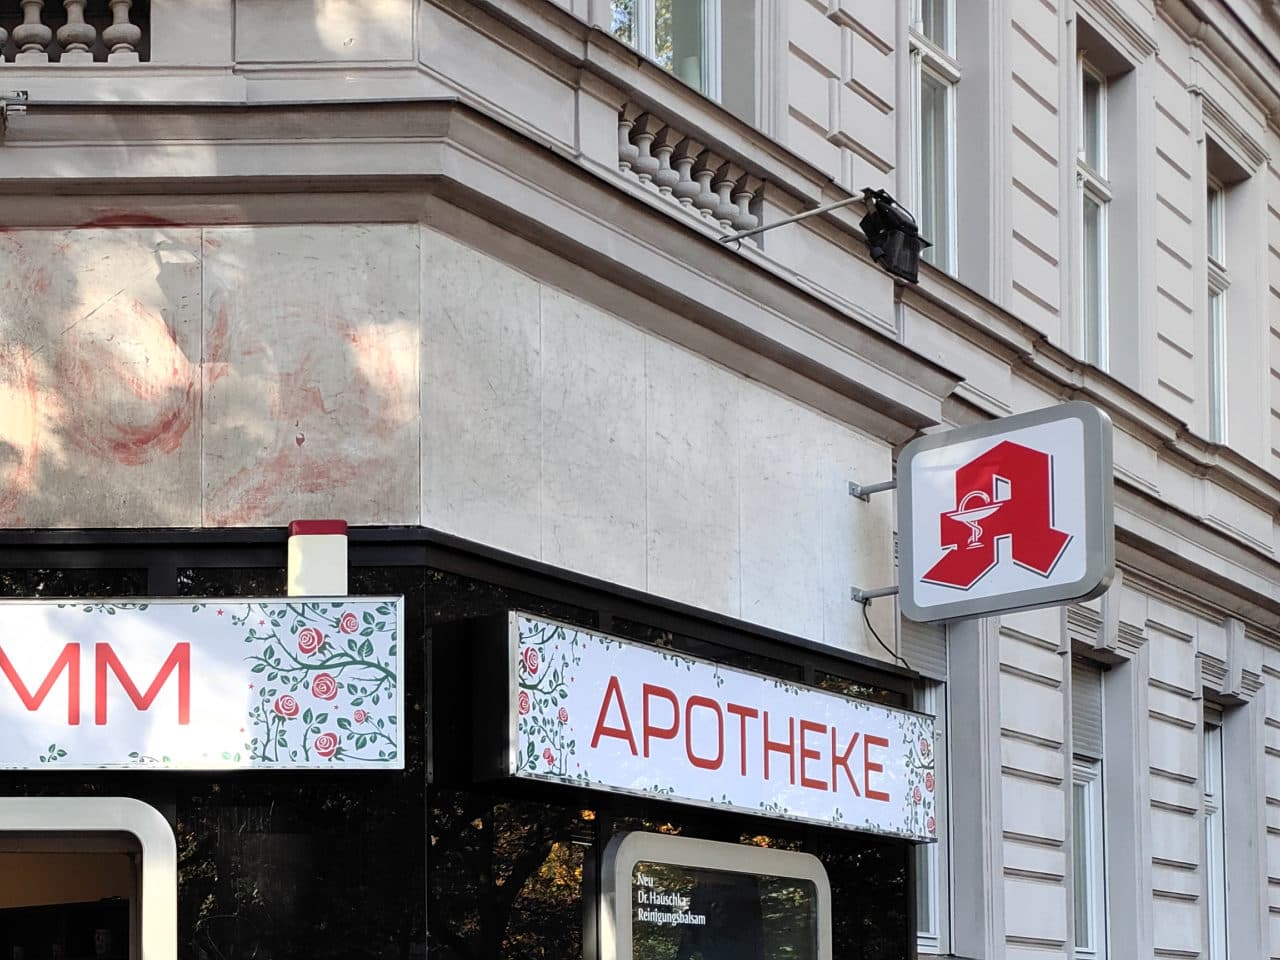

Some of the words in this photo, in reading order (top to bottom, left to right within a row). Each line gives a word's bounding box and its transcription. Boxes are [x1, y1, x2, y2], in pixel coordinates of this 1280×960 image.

[591, 676, 890, 802] APOTHEKE
[637, 872, 654, 887] Neu
[638, 890, 649, 904] Dr.
[649, 891, 687, 906] Hauschka
[638, 907, 706, 926] Reinigungsbalsam
